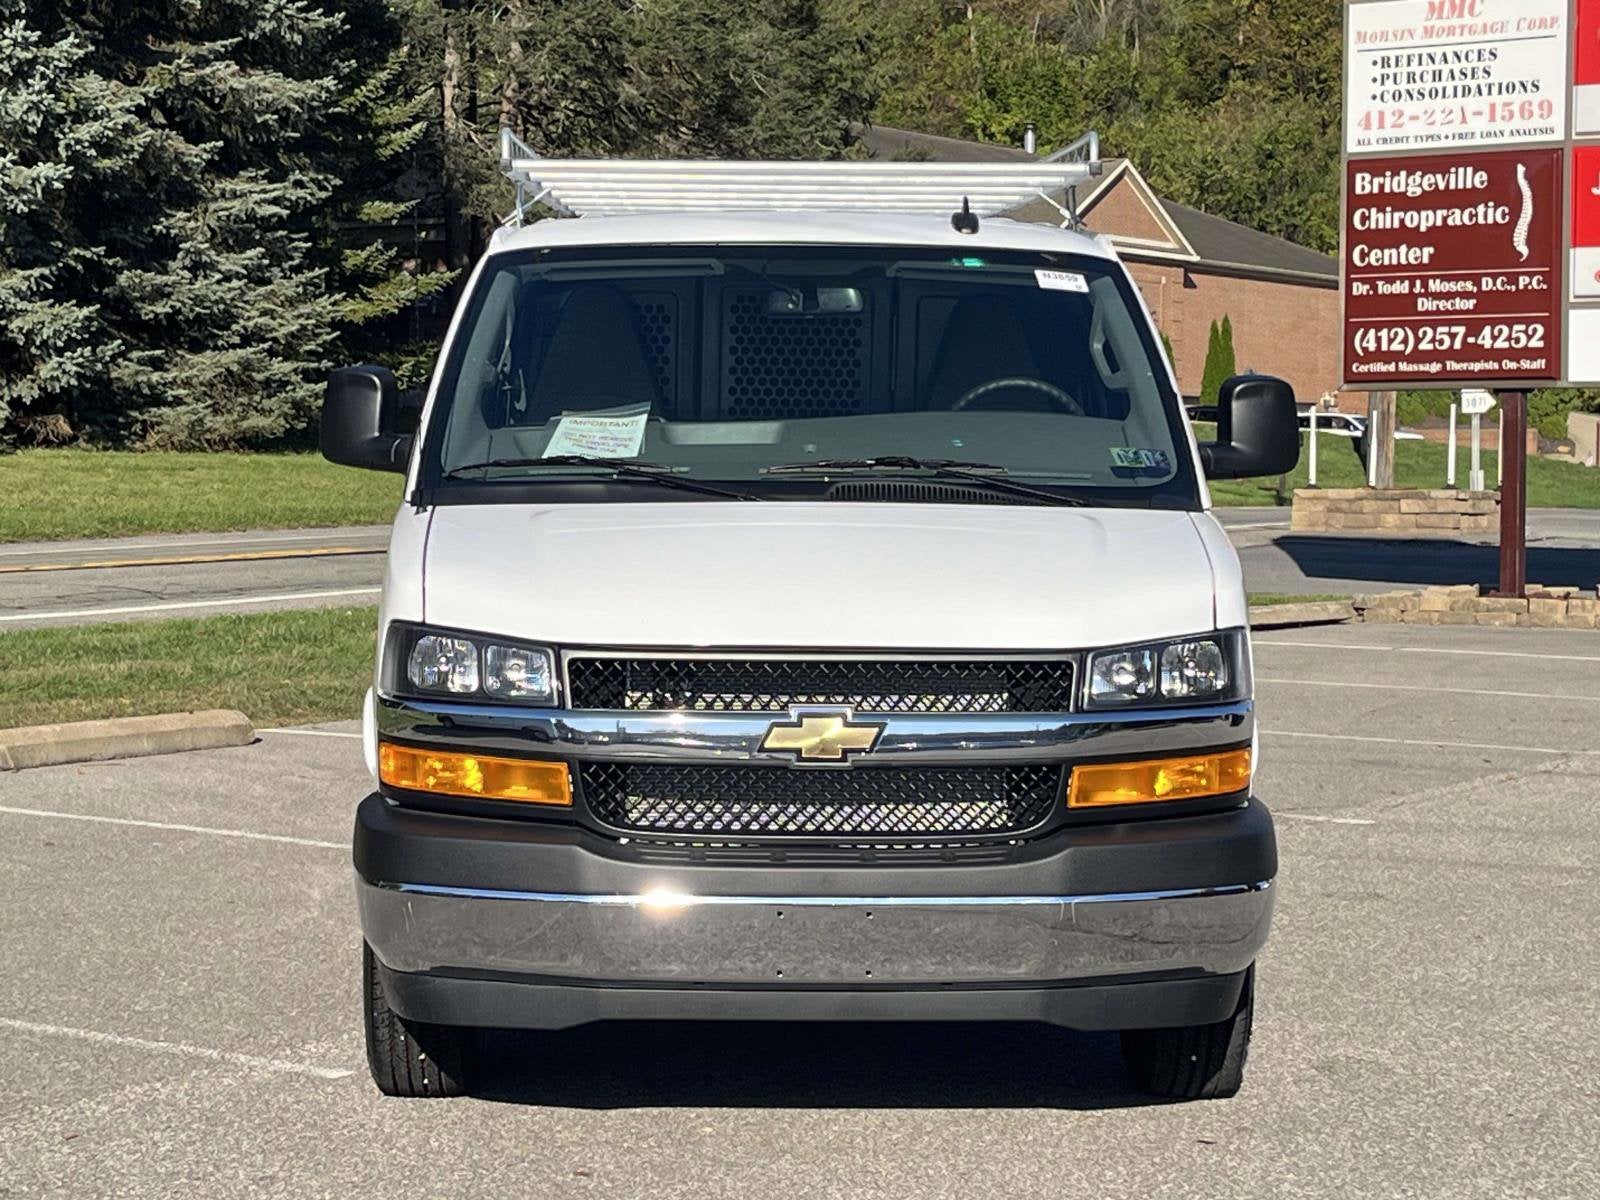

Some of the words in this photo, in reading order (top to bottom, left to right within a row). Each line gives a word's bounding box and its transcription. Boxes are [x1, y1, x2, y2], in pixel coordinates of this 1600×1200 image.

[1424, 0, 1484, 21] MMC
[1421, 20, 1510, 39] MORTGAGE
[1380, 48, 1498, 69] REFINANCES
[1380, 66, 1492, 86] PURCHASES
[1380, 79, 1541, 103] CONSOLIDATIONS
[1376, 135, 1411, 145] CREDIT
[1413, 133, 1442, 143] TYPES
[1452, 131, 1476, 141] FREE
[1480, 129, 1505, 139] LOAN
[1508, 126, 1555, 137] ANALYSIS
[1354, 166, 1488, 197] Bridgeville
[1353, 201, 1510, 232] Chiropractic
[1352, 243, 1435, 267] Center
[1352, 281, 1374, 296] Dr.
[1376, 279, 1409, 294] Todd
[1413, 279, 1425, 294] J.
[1428, 278, 1478, 293] Moses,
[1518, 274, 1548, 290] P.C.
[1417, 297, 1477, 311] Director
[1352, 361, 1396, 373] Certified
[1398, 360, 1442, 373] Massage
[1445, 359, 1500, 372] Therapists
[1501, 358, 1546, 370] On-Staff
